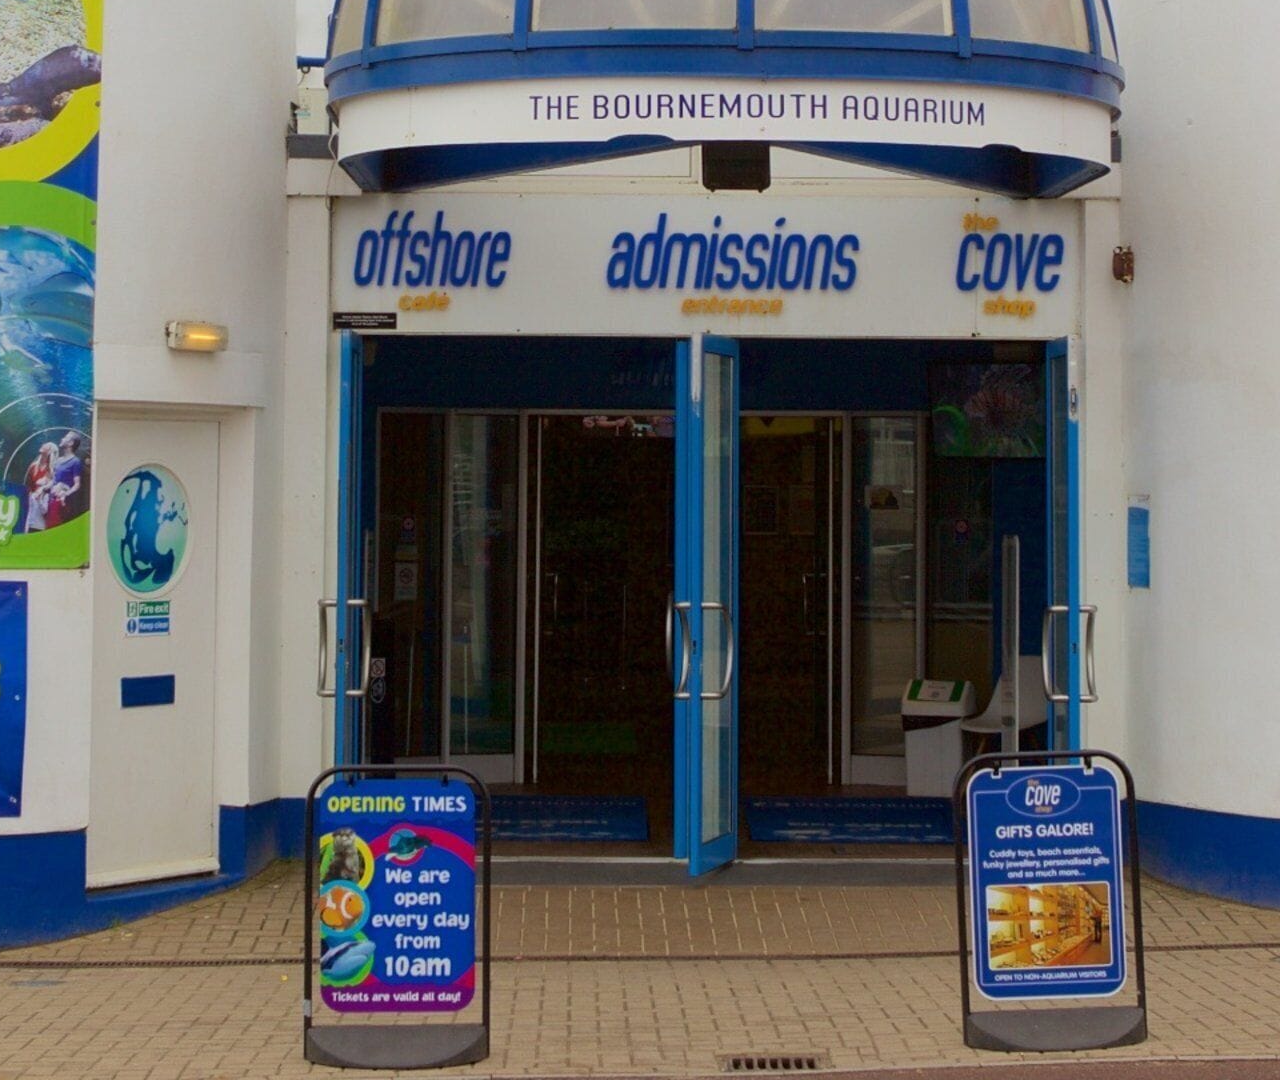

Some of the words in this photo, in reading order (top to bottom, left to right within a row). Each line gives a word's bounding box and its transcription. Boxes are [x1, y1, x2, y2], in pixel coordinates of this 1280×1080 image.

[529, 94, 580, 121] THE
[592, 92, 829, 121] BOURNEMOUTH
[842, 95, 986, 127] AQUARIUM
[962, 212, 1000, 232] the
[353, 210, 512, 288] offshore
[606, 212, 860, 291] admissions
[955, 232, 1065, 293] cove
[681, 295, 784, 316] entrance
[983, 294, 1037, 318] shop
[1024, 783, 1062, 807] cove
[327, 796, 406, 813] OPENING
[411, 796, 467, 813] TIMES
[995, 824, 1033, 839] GIFTS
[1035, 822, 1094, 838] GALORE!
[989, 848, 1017, 859] Cuddly
[1037, 846, 1062, 857] beach
[983, 858, 1004, 870] funky
[1093, 855, 1110, 867] gifts
[384, 868, 413, 884] We
[418, 869, 451, 884] are
[1007, 870, 1024, 879] and
[1025, 870, 1034, 878] so
[1035, 869, 1058, 878] much
[394, 891, 441, 908] open
[371, 913, 428, 930] every
[433, 911, 470, 930] day
[394, 933, 441, 949] from
[385, 956, 451, 976] 10am
[994, 973, 1013, 982] OPEN
[1014, 973, 1024, 981] TO
[1024, 971, 1078, 981] NON-AQUARIUM
[1078, 970, 1107, 980] VISITORS
[331, 991, 369, 1003] Tickets
[371, 992, 390, 1003] are
[392, 991, 420, 1002] valid
[422, 991, 435, 1002] all
[437, 991, 461, 1003] day!
